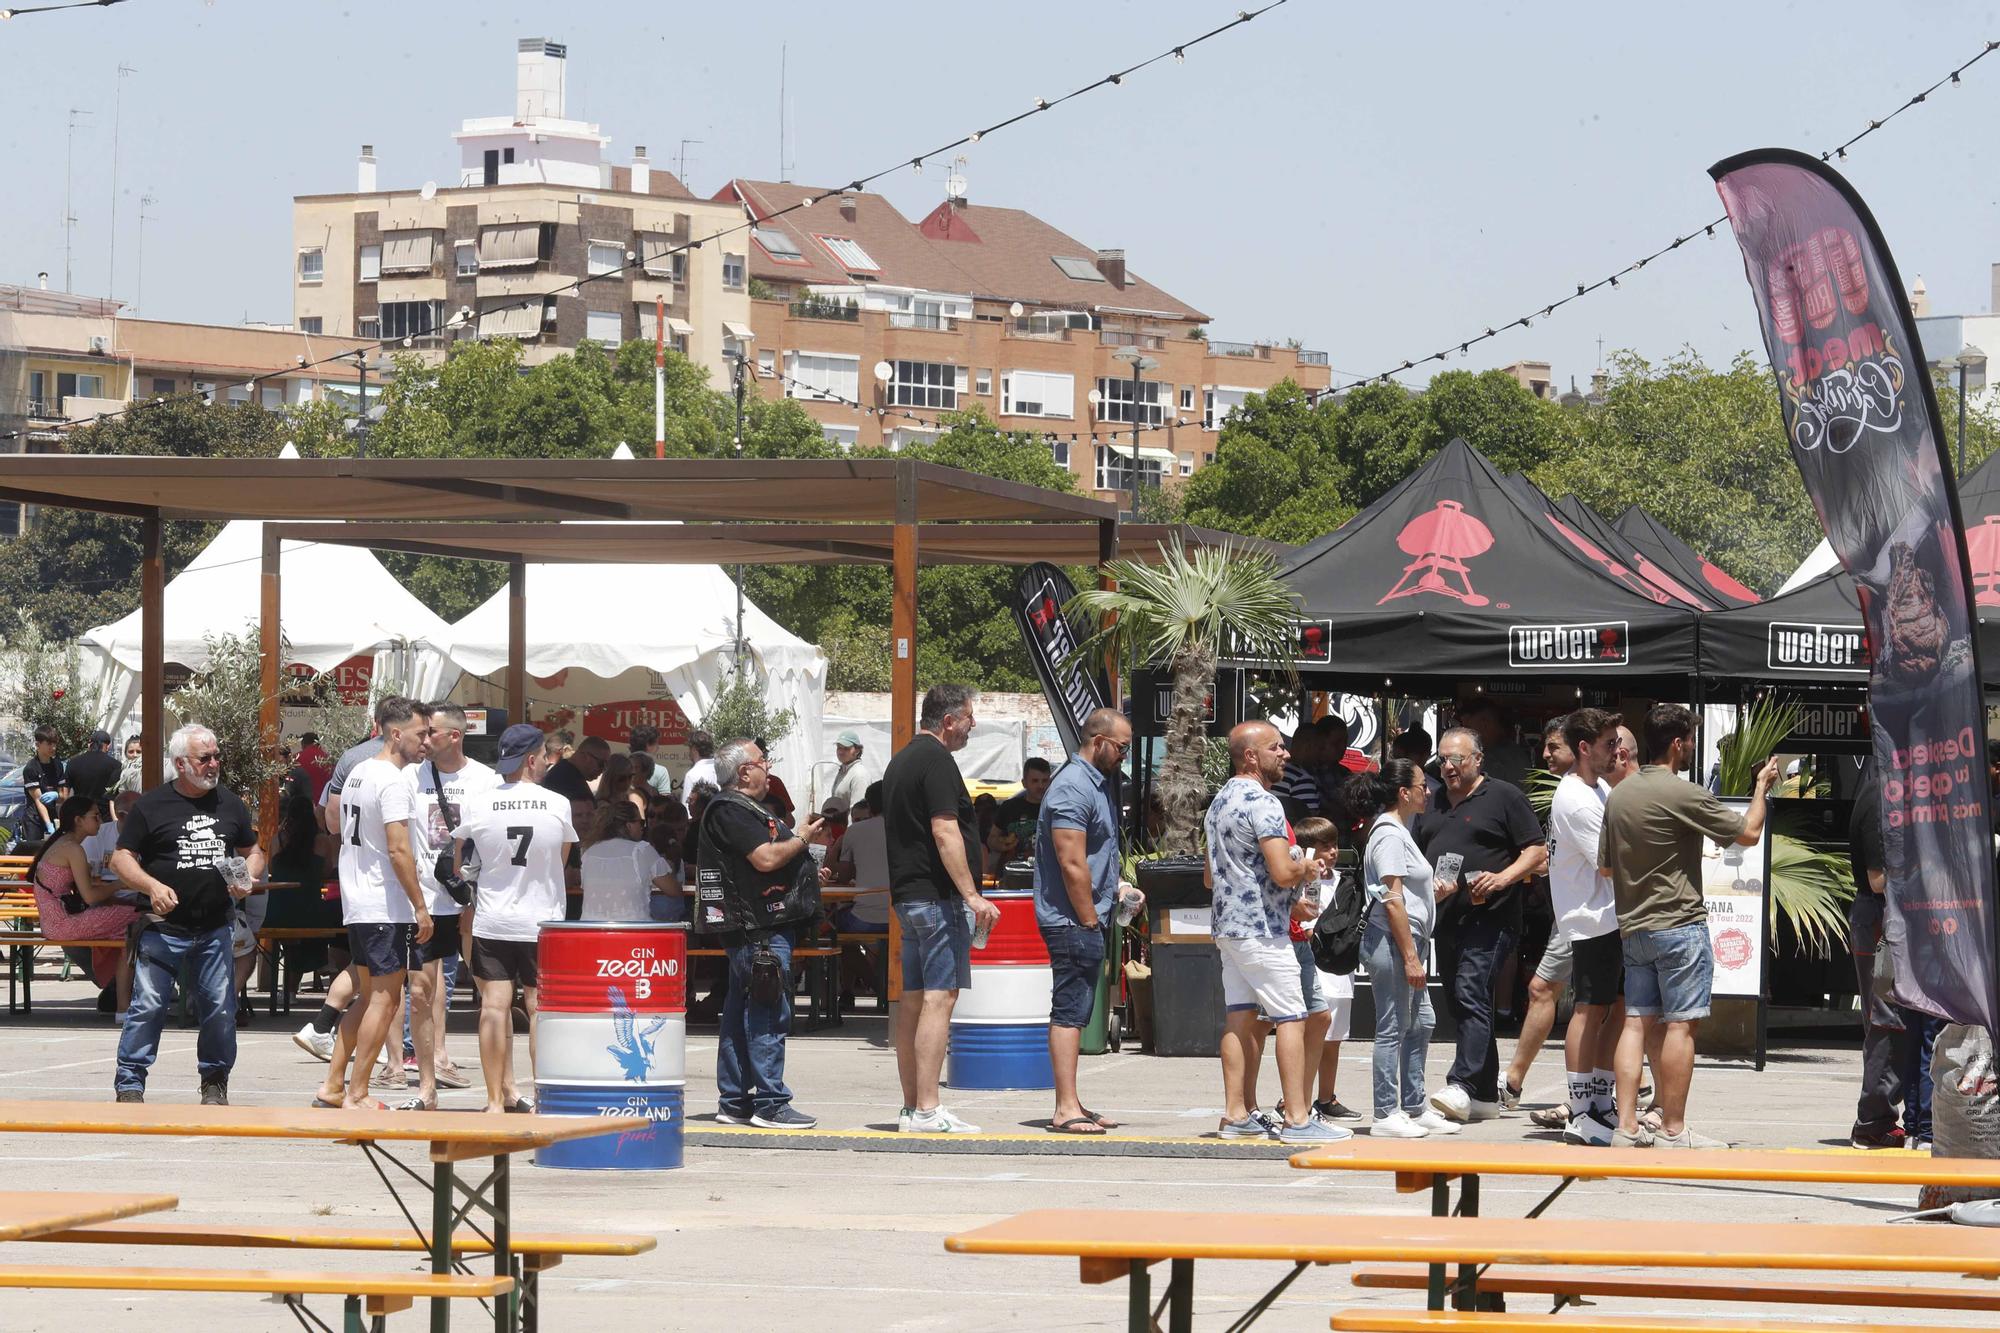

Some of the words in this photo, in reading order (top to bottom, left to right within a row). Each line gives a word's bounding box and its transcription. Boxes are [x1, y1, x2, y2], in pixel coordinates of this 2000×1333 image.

[1517, 627, 1598, 660] weber
[1777, 628, 1859, 664] weber
[610, 710, 688, 729] JUBES
[493, 800, 547, 811] OSKITAR
[185, 840, 222, 848] MOTERO
[507, 826, 533, 867] 7
[1717, 914, 1734, 922] Tour
[1735, 914, 1753, 922] 2022
[631, 948, 655, 958] GIN
[627, 1097, 648, 1106] GIN
